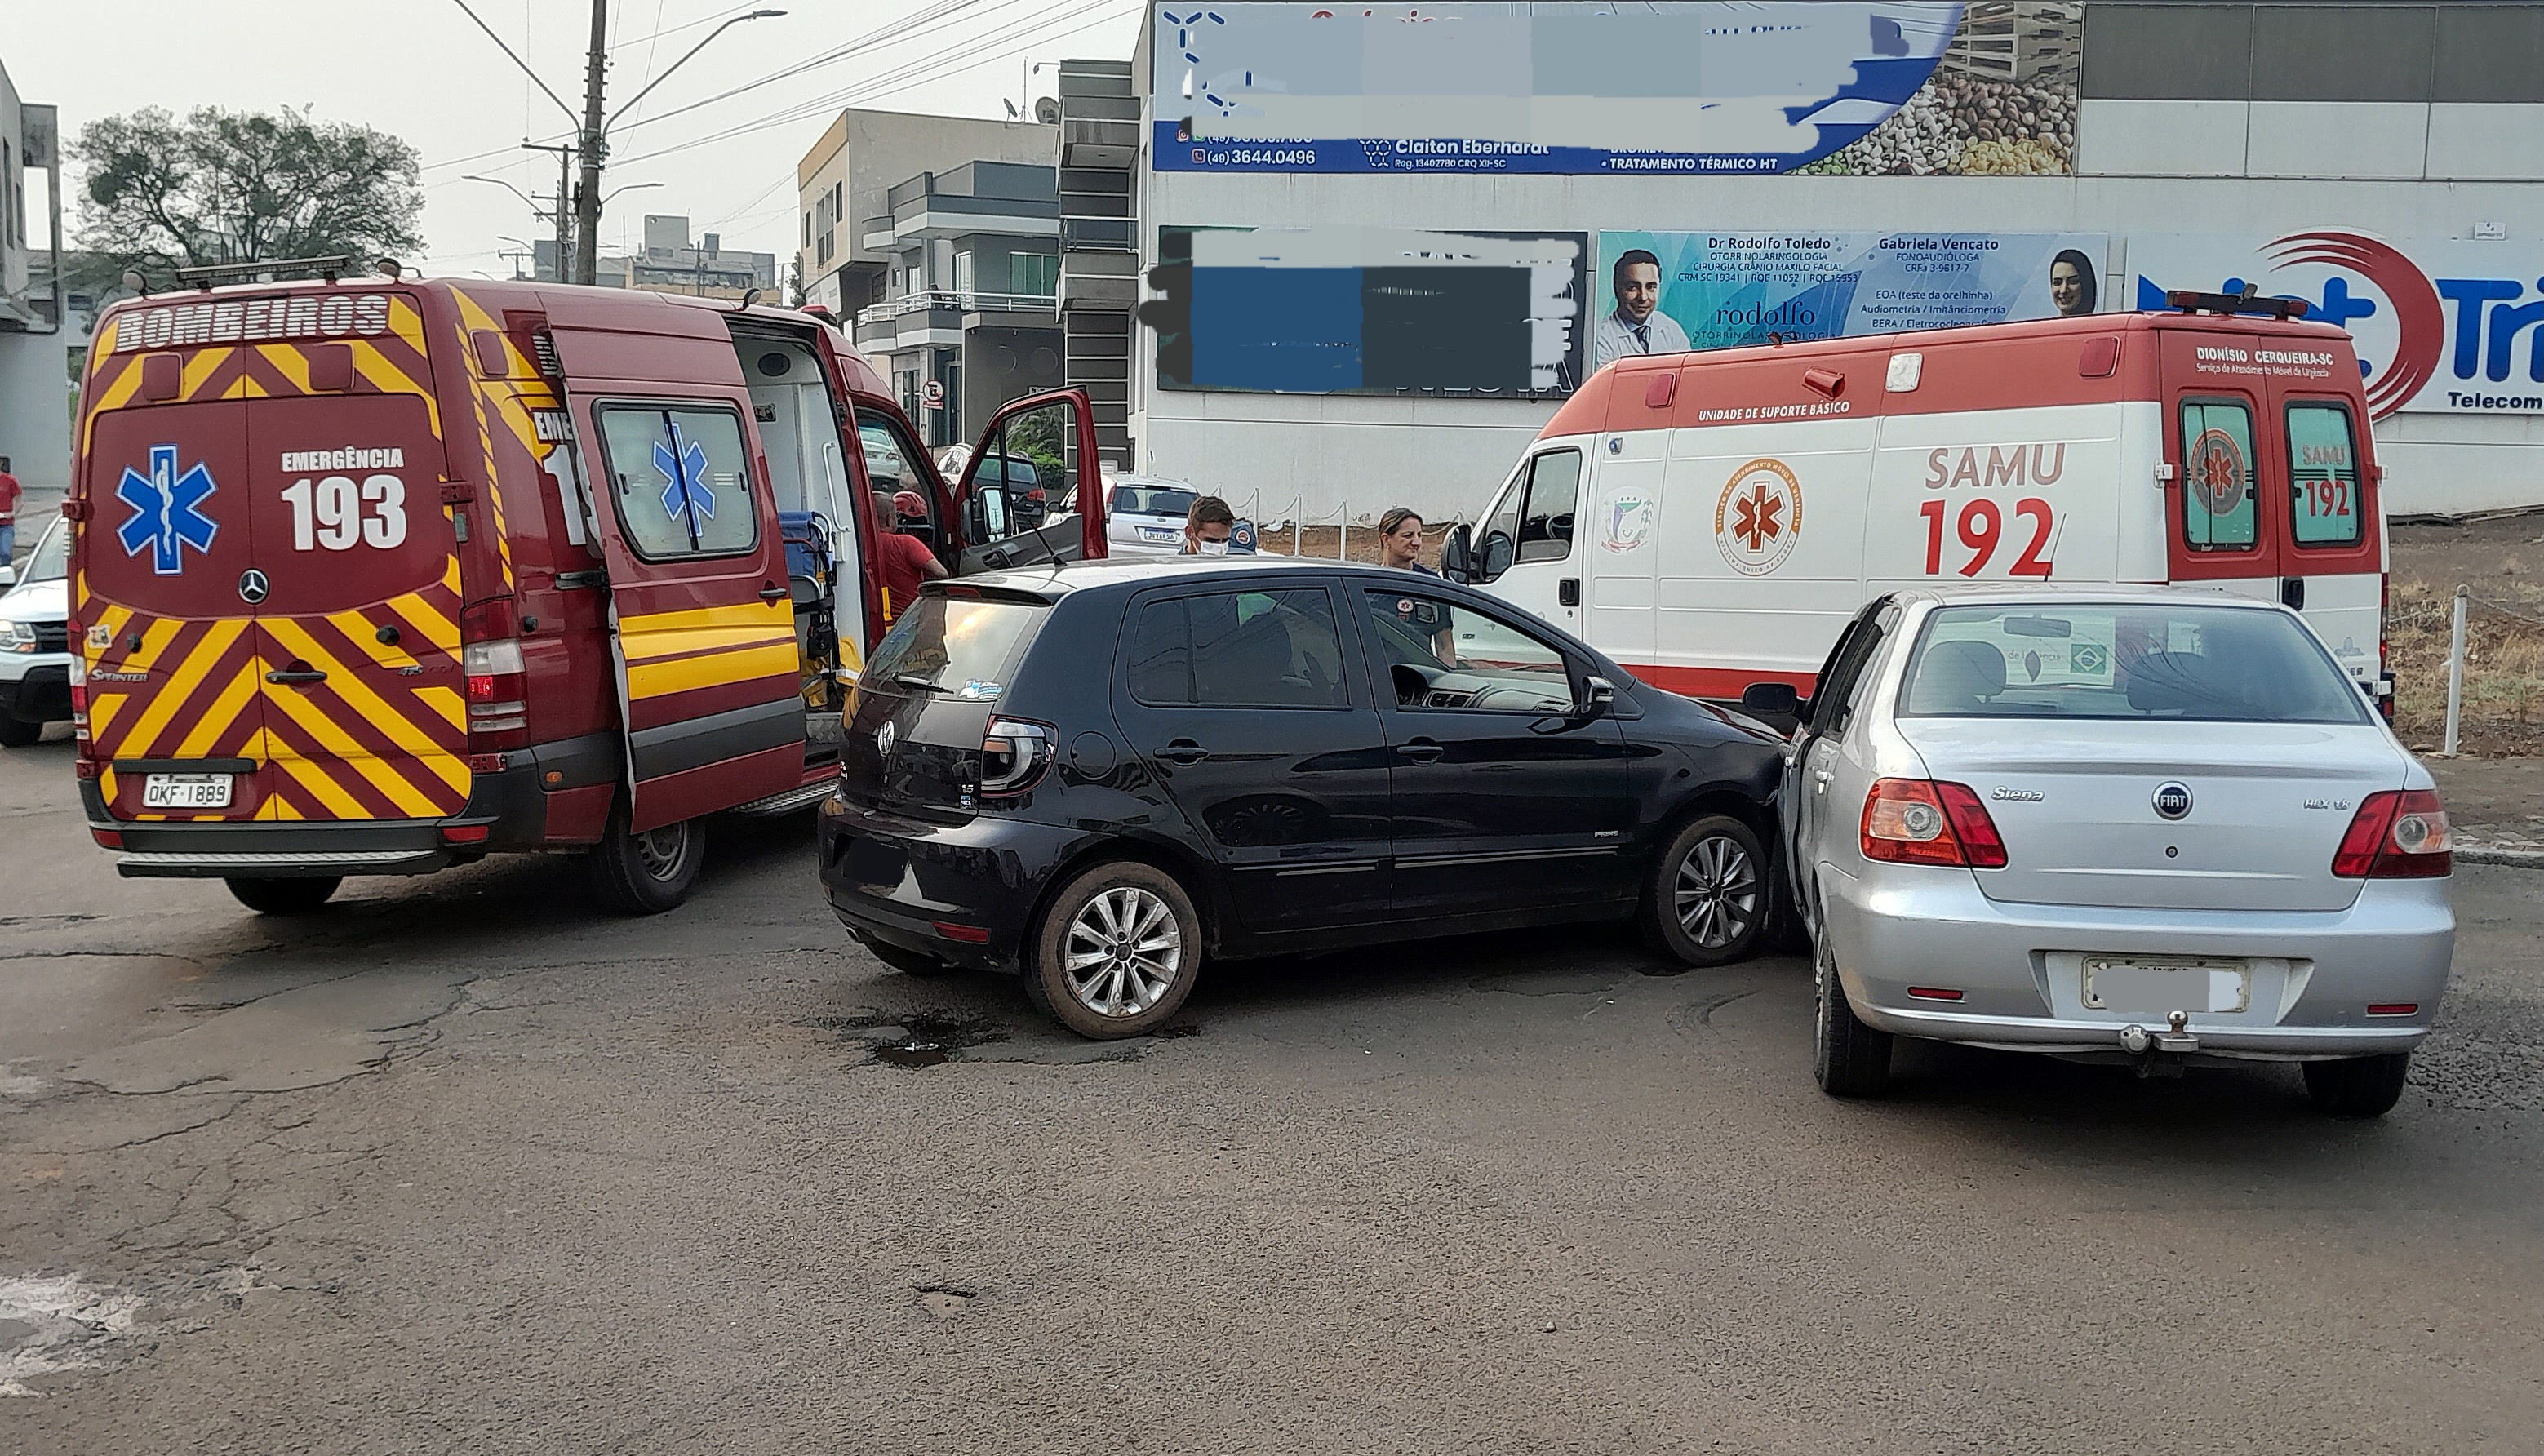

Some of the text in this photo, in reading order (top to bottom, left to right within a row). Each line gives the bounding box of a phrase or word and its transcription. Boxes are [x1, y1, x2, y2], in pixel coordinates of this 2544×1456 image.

[1396, 139, 1458, 155] Claiton
[1232, 149, 1316, 164] 3644.0496
[1458, 159, 1477, 168] CRQ
[1609, 155, 1778, 170] TRATAMENTO TÉRMICO HT
[1708, 237, 1831, 250] Dr Rodolfo Toledo
[1879, 238, 1999, 251] Gabriela Vencato
[1710, 252, 1828, 261] OTORRINOLARINGOLOGIA
[1896, 251, 1980, 261] FONOAUDIÓLOGA
[1693, 263, 1736, 272] CIRURGIA
[1775, 263, 1811, 272] MAXILO
[1813, 263, 1844, 272] FACIAL
[1905, 264, 1928, 272] CRFa
[1678, 273, 1698, 282] CRM
[1700, 273, 1712, 282] SC
[1715, 273, 1741, 282] 19341
[1751, 273, 1770, 282] RQE
[1773, 273, 1800, 282] 11052
[1876, 290, 1993, 300] EOA (teste da orelhinha)
[1715, 300, 1815, 326] rodolfo
[1860, 304, 1920, 313] Audiometria
[116, 295, 388, 353] BOMBEIROS
[1872, 319, 1897, 328] BERA
[2195, 346, 2333, 366] DIONÍSIO CERQUEIRA-SC
[2196, 362, 2221, 375] Serviço
[2222, 364, 2230, 373] de
[2448, 392, 2543, 409] Telecom
[1698, 400, 1850, 422] UNIDADE DE SUPORTE BÁSICO
[281, 446, 405, 473] EMERGÊNCIA
[2302, 444, 2346, 465] SAMU
[1925, 442, 2067, 490] SAMU
[2305, 480, 2351, 517] 192
[281, 475, 406, 552] 193
[1920, 497, 2053, 578] 192
[1991, 785, 2045, 802] Siena
[2160, 794, 2187, 807] FIAT
